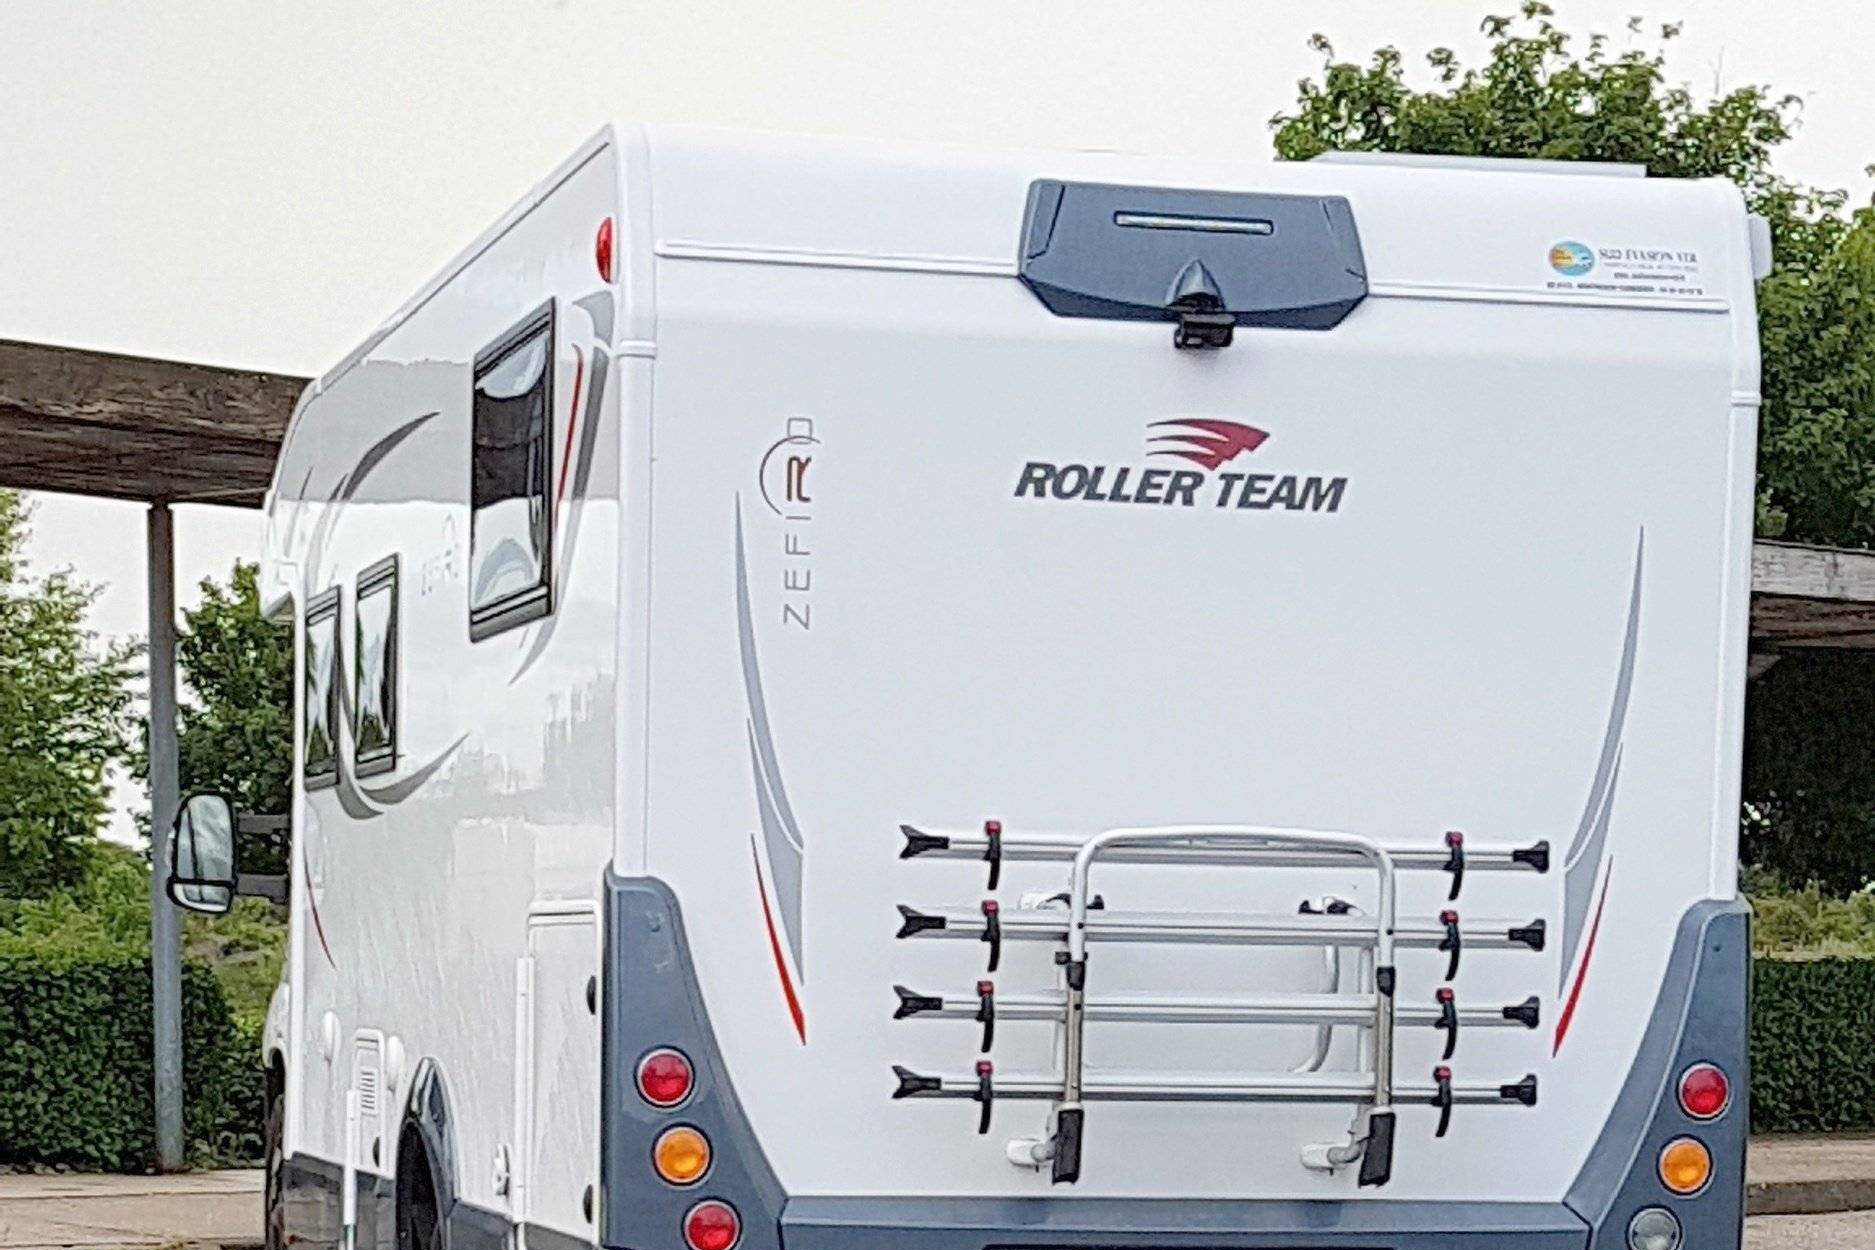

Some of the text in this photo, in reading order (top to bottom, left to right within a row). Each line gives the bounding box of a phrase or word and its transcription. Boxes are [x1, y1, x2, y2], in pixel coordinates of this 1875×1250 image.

[780, 417, 815, 631] ZEFIRO
[1014, 461, 1348, 513] ROLLER TEAM
